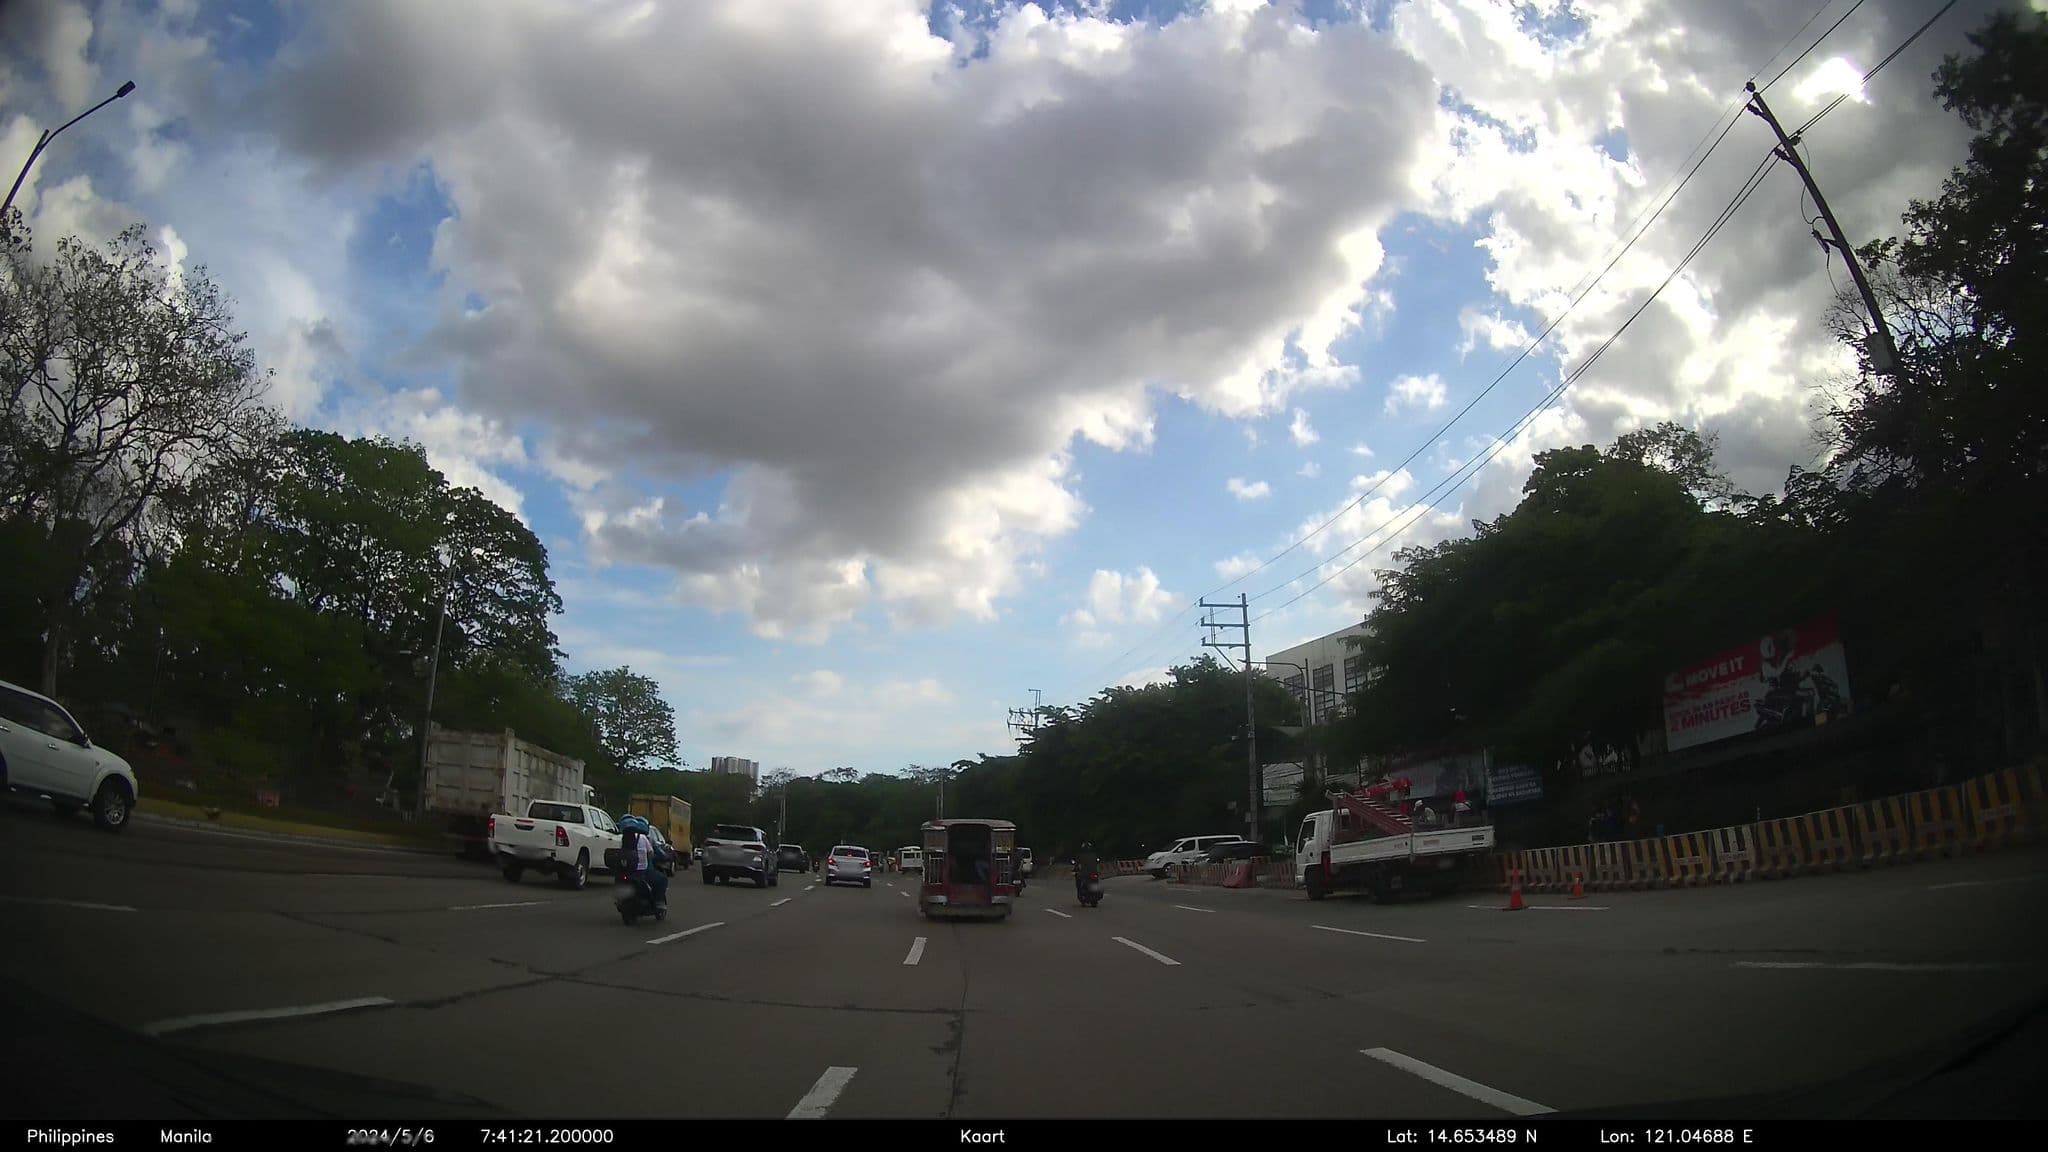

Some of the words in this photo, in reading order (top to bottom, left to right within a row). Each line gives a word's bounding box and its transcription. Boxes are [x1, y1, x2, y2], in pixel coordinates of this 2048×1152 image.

[1685, 662, 1729, 688] MOVE
[1729, 655, 1745, 673] IT
[1681, 700, 1752, 729] MINUTES
